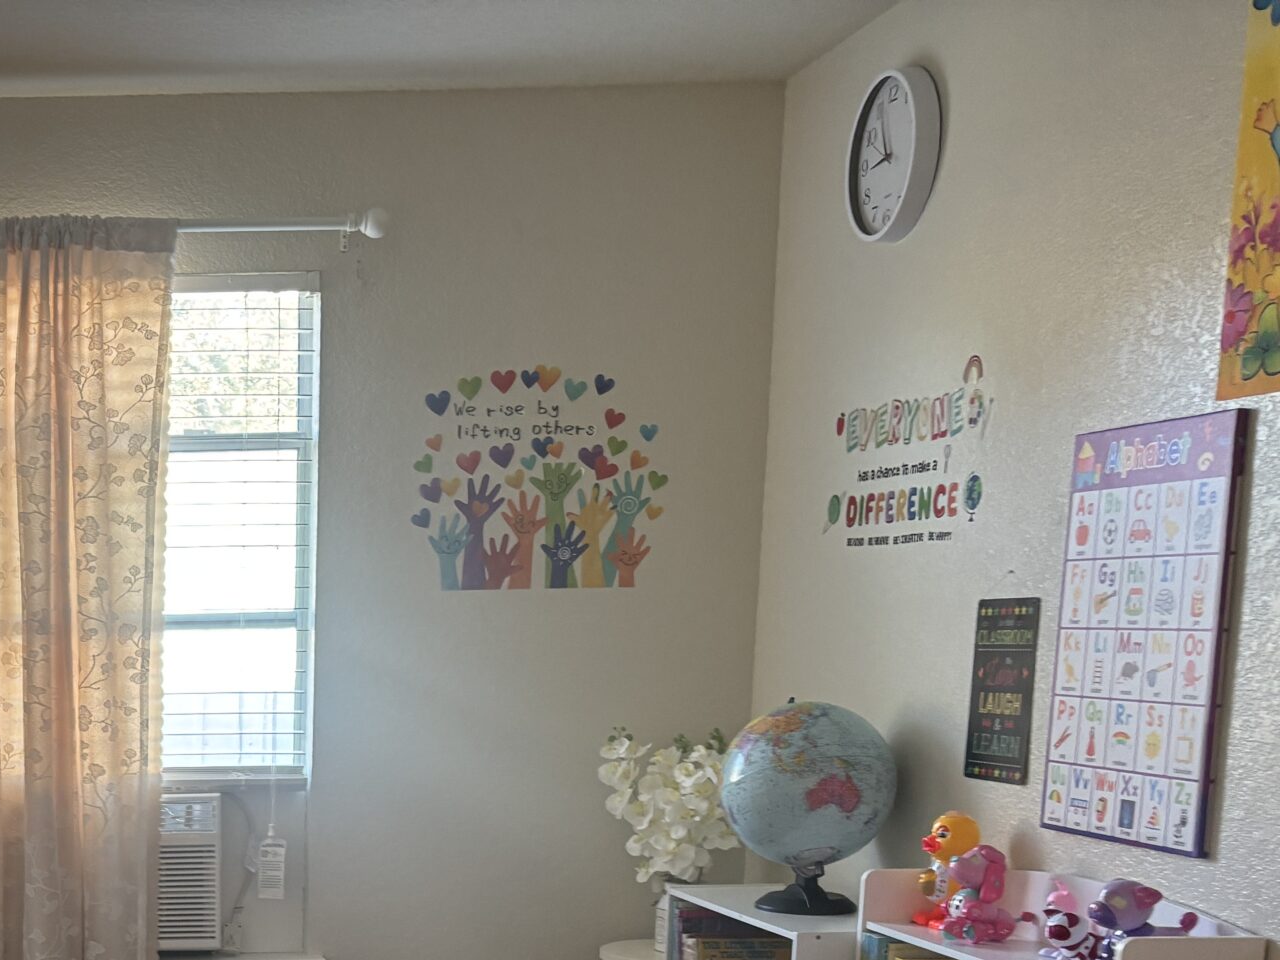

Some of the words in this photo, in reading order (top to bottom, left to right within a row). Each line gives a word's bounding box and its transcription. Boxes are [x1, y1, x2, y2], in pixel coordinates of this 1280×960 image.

[888, 84, 899, 103] 12
[861, 159, 869, 177] 9
[863, 188, 872, 205] 8
[454, 400, 476, 417] We
[486, 403, 525, 417] rise
[538, 400, 559, 418] by
[847, 387, 965, 453] EVERYONE
[457, 424, 521, 441] lifting
[532, 422, 596, 437] others
[1104, 430, 1192, 479] Alphabet
[876, 466, 901, 479] chance
[911, 461, 931, 474] make
[846, 481, 959, 528] DIFFERENCE
[1075, 494, 1095, 517] Aa
[1104, 491, 1122, 514] Bb
[1135, 488, 1153, 511] Cc
[1197, 481, 1217, 507] Ee
[1071, 563, 1088, 584] Ff
[1099, 562, 1116, 587] Gg
[1127, 560, 1146, 584] Hh
[1160, 559, 1176, 582] Ii
[1192, 557, 1209, 584] Jj
[977, 629, 1032, 645] CLASSROOM
[1064, 631, 1081, 652] Kk
[1094, 631, 1107, 653] Ll
[1117, 631, 1143, 654] Mm
[1151, 632, 1171, 655] Nn
[1183, 633, 1205, 656] Oo
[978, 691, 1023, 716] LAUGH
[1057, 699, 1077, 721] Pp
[1085, 700, 1103, 725] Qq
[1115, 703, 1133, 725] Rr
[1145, 704, 1164, 727] Ss
[972, 733, 1022, 758] LEARN
[1073, 768, 1090, 789] Vv
[1095, 771, 1117, 792] Ww
[1120, 775, 1139, 796] Xx
[1149, 779, 1164, 805] Yy
[1176, 782, 1196, 806] Zz
